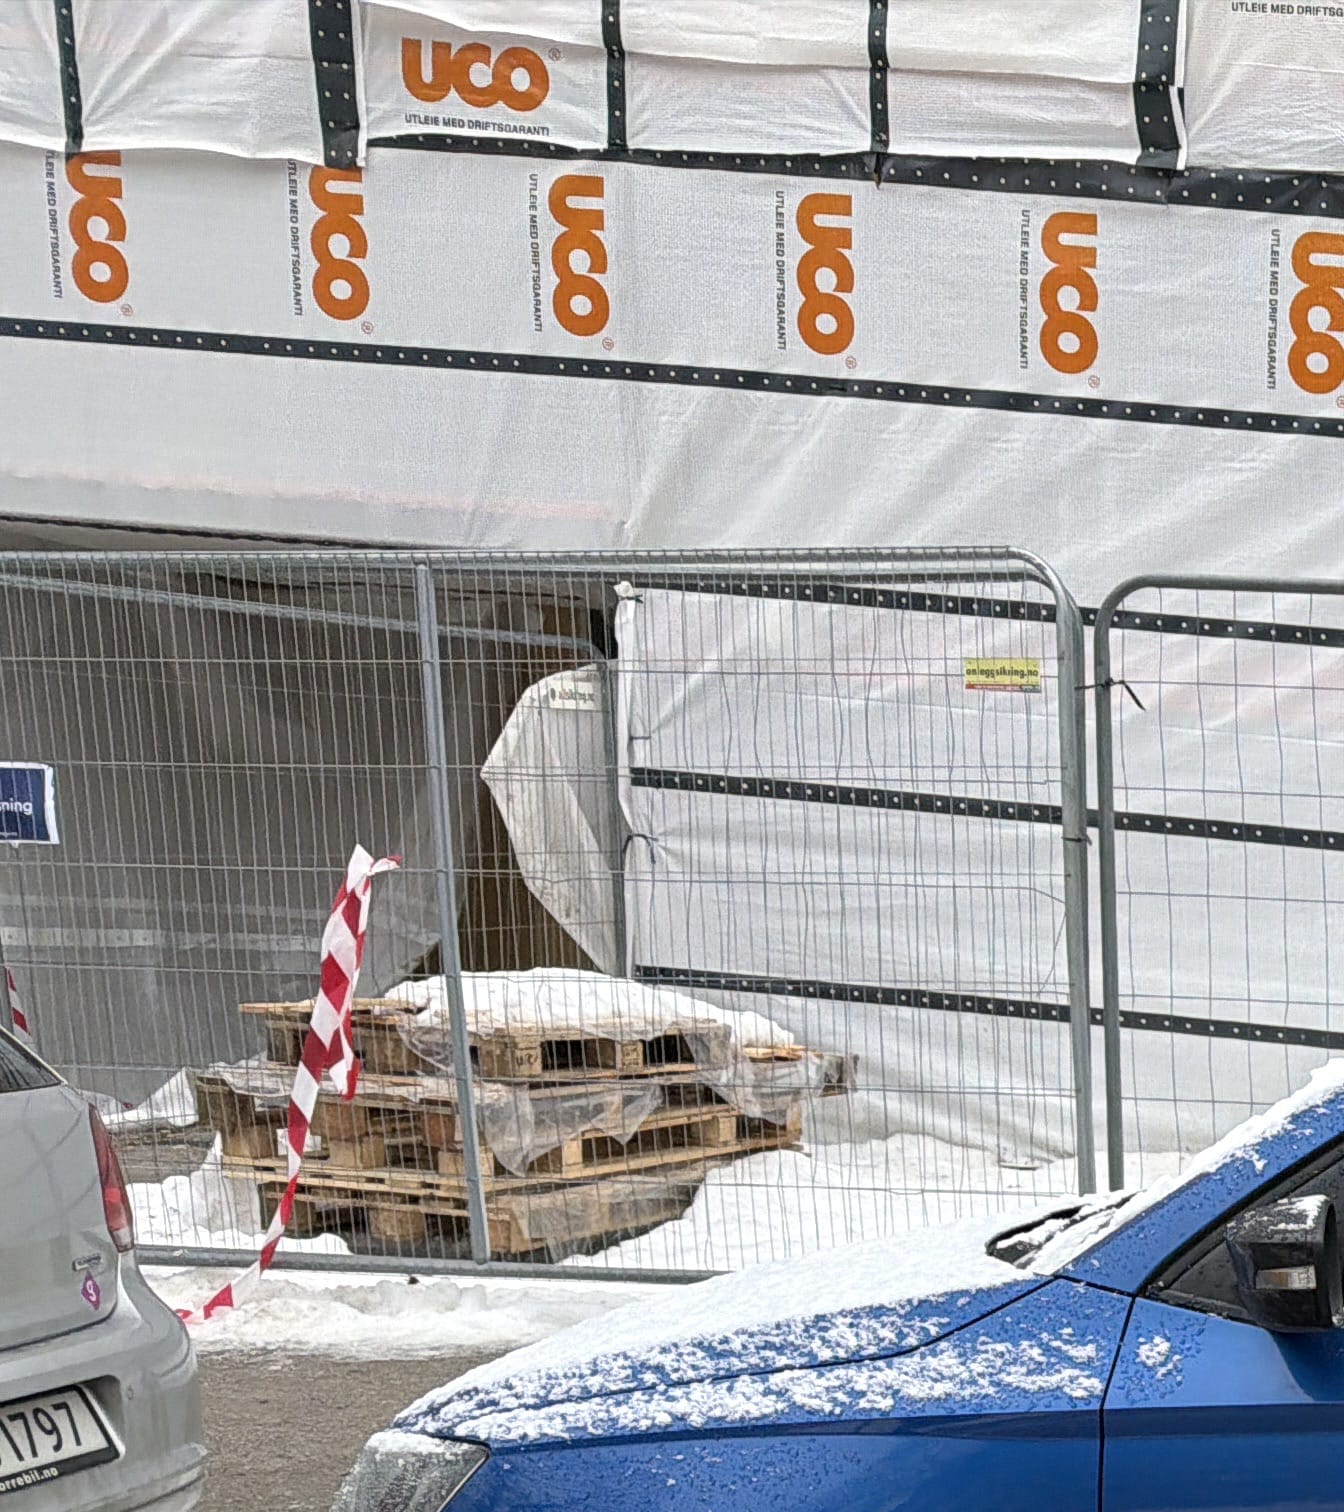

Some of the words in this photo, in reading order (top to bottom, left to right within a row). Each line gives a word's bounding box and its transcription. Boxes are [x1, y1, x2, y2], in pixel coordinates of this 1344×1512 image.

[1231, 1, 1268, 14] UTLEIE
[1270, 2, 1295, 15] MED
[402, 37, 550, 112] UCO
[404, 112, 442, 127] UTLEIE
[442, 116, 468, 129] MED
[467, 119, 552, 136] DRIFTSGARANTI
[45, 180, 57, 207] MED
[288, 198, 299, 225] MED
[528, 173, 538, 212] UTLEIE
[775, 190, 785, 230] UTLEIE
[48, 208, 63, 299] DRIFTSGARANTI
[66, 150, 130, 304] UCO
[309, 166, 371, 322] UCO
[528, 213, 539, 240] MED
[547, 174, 610, 337] UCO
[775, 231, 786, 258] MED
[1020, 209, 1031, 249] UTLEIE
[1269, 228, 1281, 269] UTLEIE
[290, 226, 303, 317] DRIFTSGARANTI
[530, 241, 543, 333] DRIFTSGARANTI
[796, 192, 856, 356] UCO
[1019, 249, 1029, 276] MED
[1269, 270, 1280, 297] MED
[775, 259, 787, 351] DRIFTSGARANTI
[1039, 211, 1100, 375] UCO
[1019, 277, 1029, 370] DRIFTSGARANTI
[1266, 298, 1279, 391] DRIFTSGARANTI
